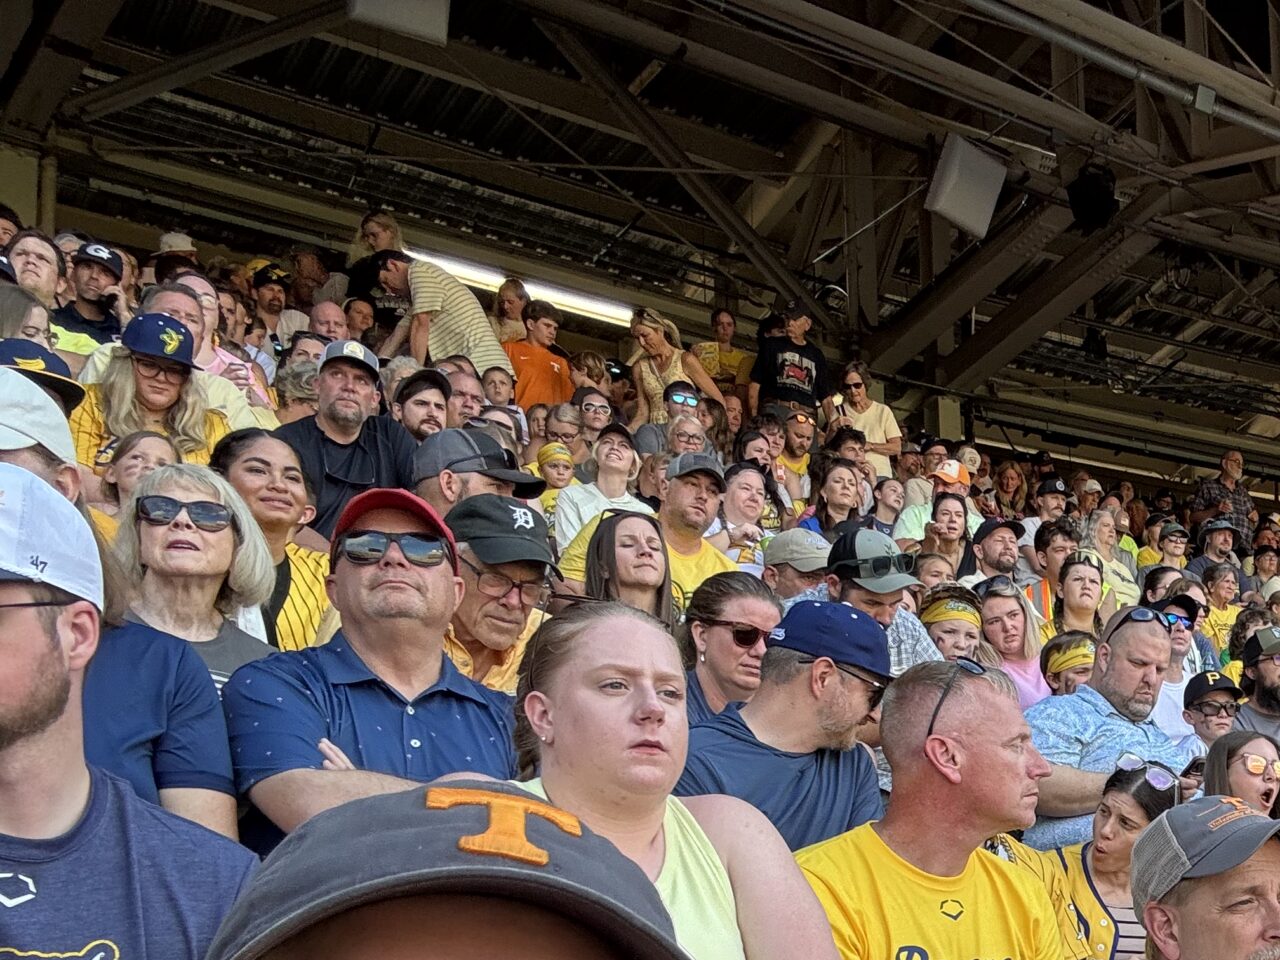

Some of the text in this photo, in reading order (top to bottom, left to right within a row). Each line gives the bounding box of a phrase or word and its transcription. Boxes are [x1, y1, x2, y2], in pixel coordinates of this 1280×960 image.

[508, 504, 535, 529] D
[1206, 672, 1221, 685] P
[425, 787, 582, 866] T
